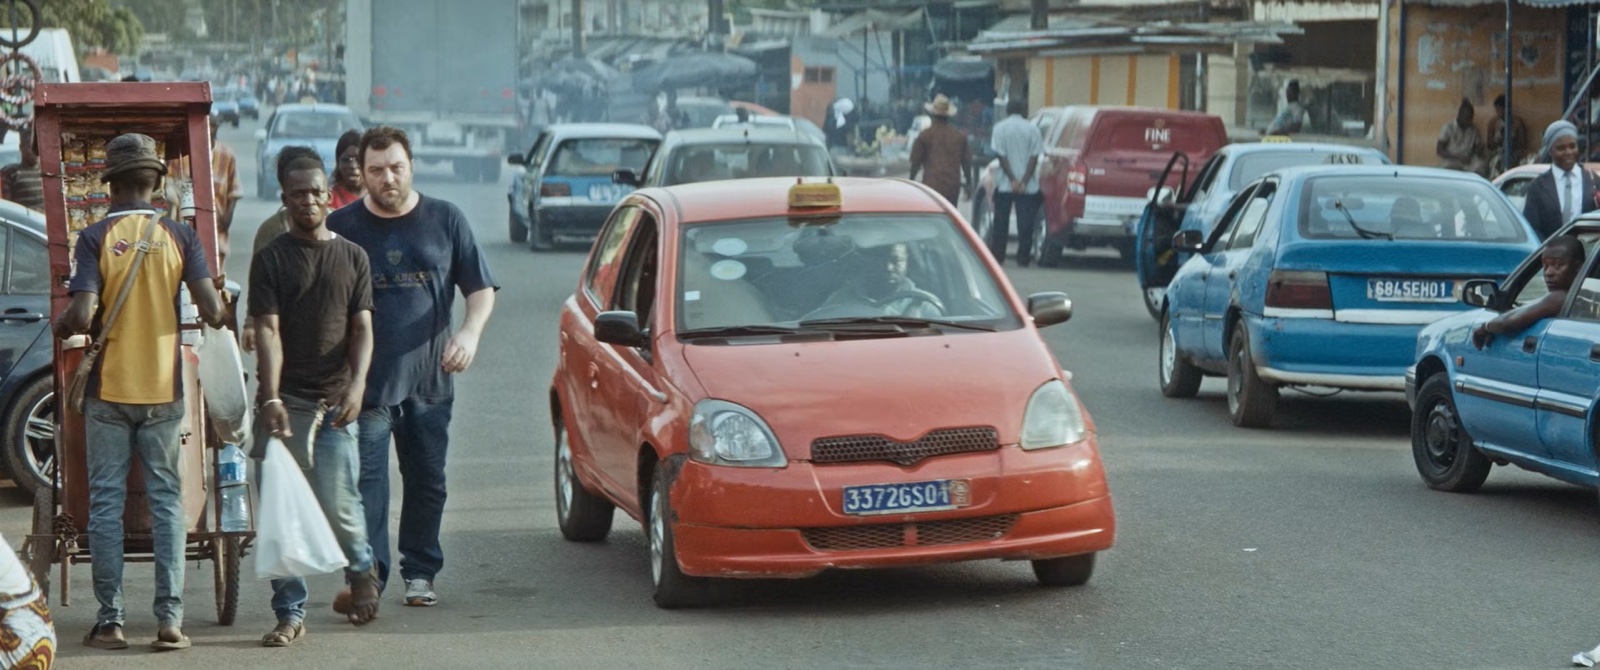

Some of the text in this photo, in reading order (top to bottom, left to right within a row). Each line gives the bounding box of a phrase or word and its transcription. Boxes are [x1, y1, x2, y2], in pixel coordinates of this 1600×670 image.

[1144, 127, 1171, 143] FINE
[1329, 153, 1360, 165] TAXI
[1376, 281, 1446, 298] 6845EH01
[847, 483, 949, 510] 3372GS01
